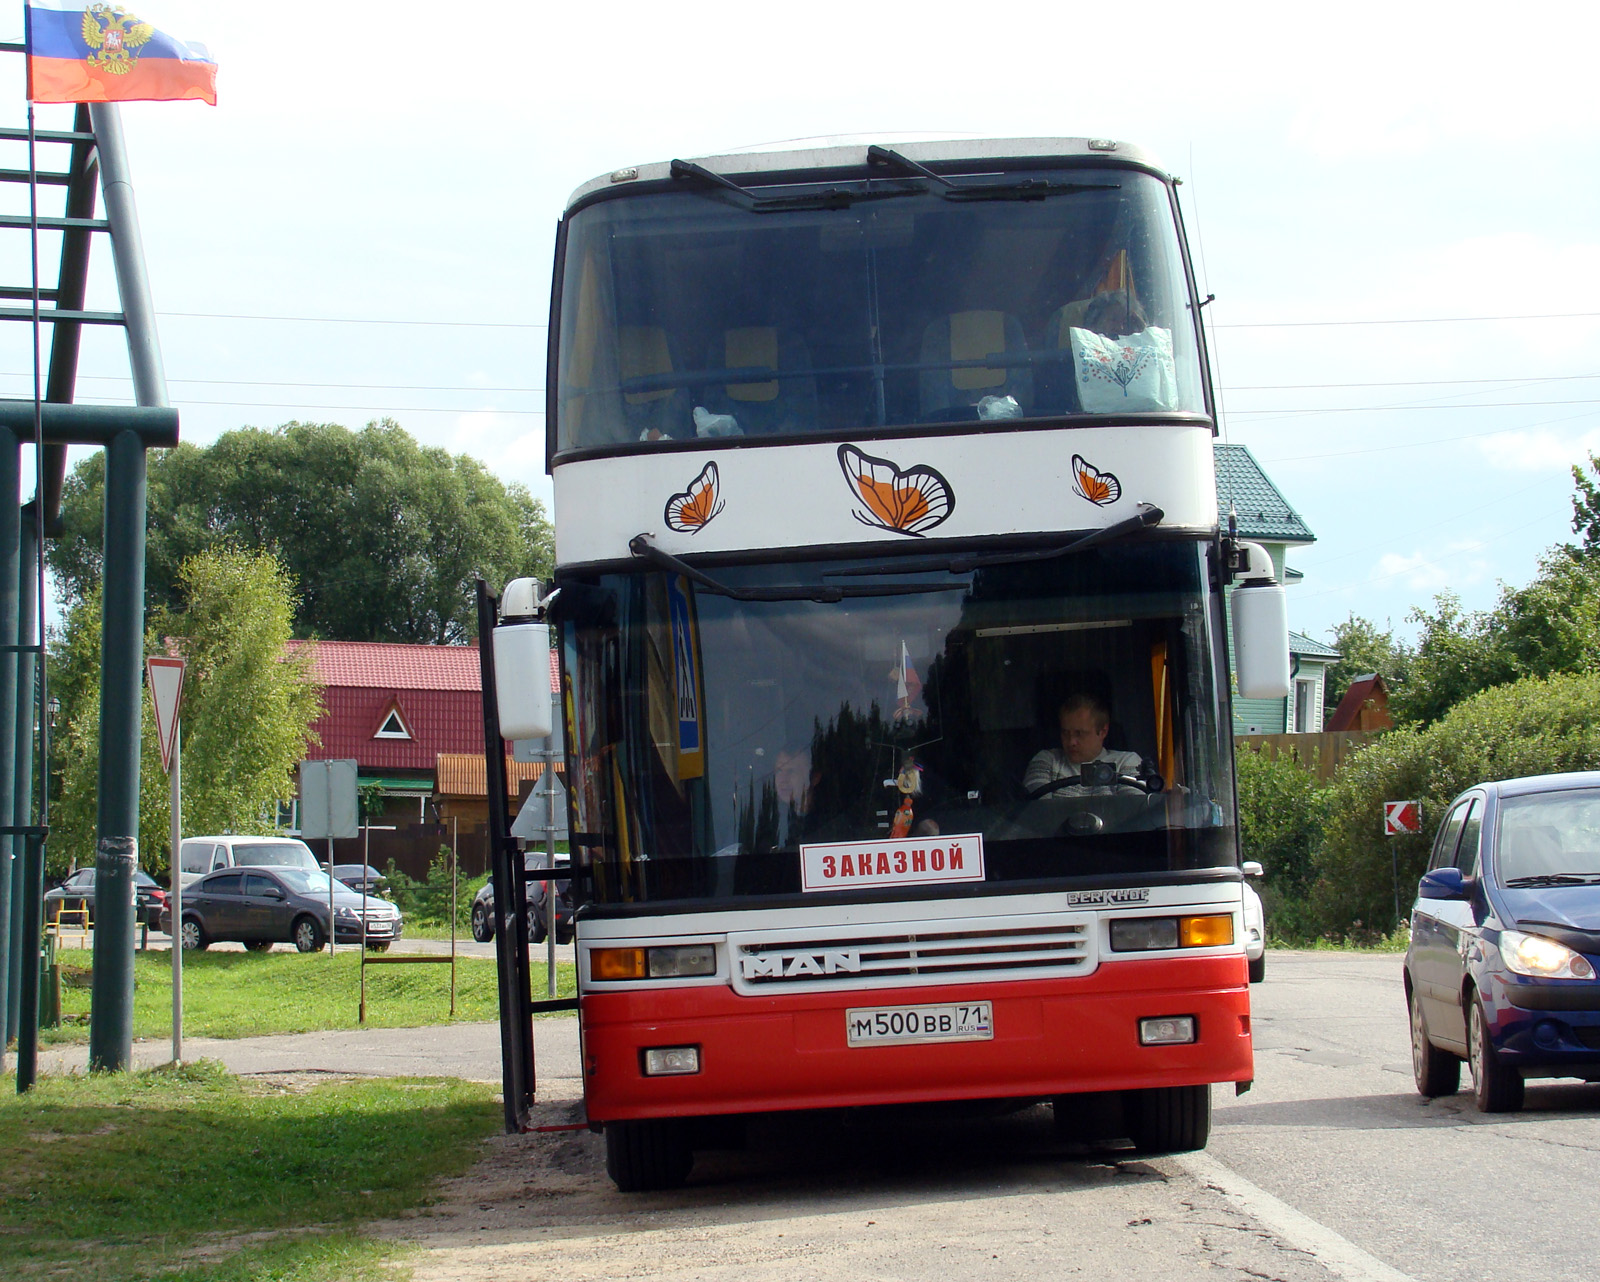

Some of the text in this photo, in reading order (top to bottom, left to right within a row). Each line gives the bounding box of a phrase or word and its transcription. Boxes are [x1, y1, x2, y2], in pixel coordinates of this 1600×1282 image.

[822, 843, 964, 879] ЗАКАЗНОЙ
[1067, 888, 1150, 908] BERKHOF
[743, 949, 861, 979] MAN
[958, 1006, 982, 1025] 71
